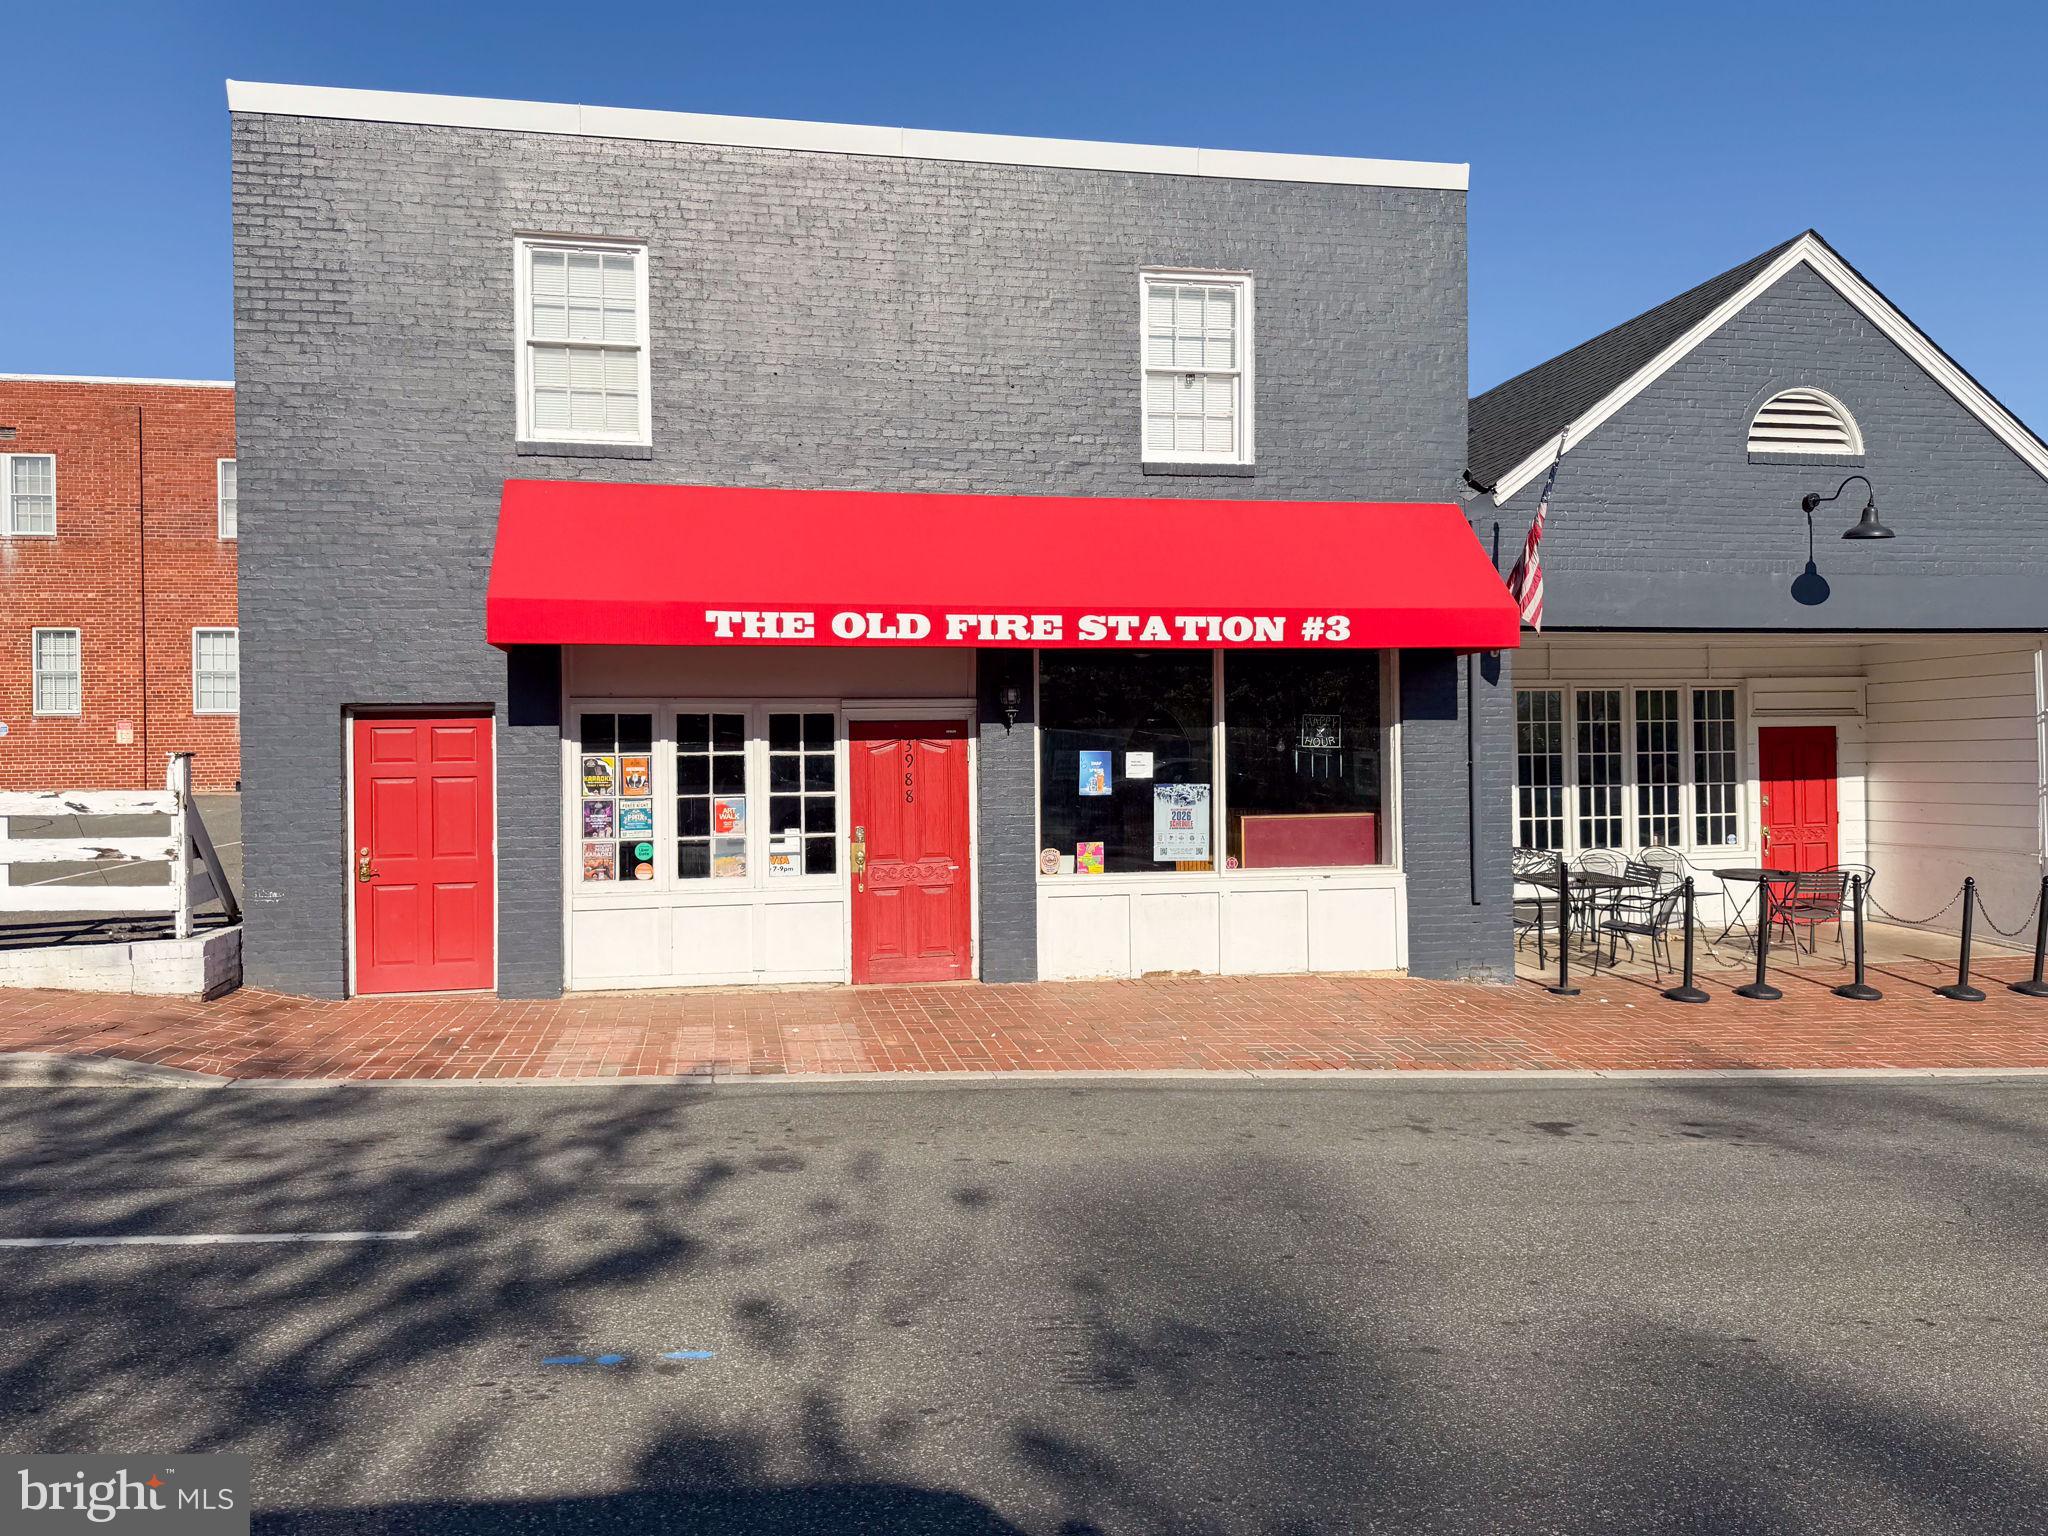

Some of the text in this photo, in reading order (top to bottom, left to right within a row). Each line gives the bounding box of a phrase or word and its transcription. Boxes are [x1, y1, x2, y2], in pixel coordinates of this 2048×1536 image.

[705, 610, 1351, 642] THE OLD FIRE STATION #3
[1304, 736, 1336, 747] HOUR
[1171, 810, 1192, 821] 2026
[1169, 820, 1194, 828] SCHEDULE
